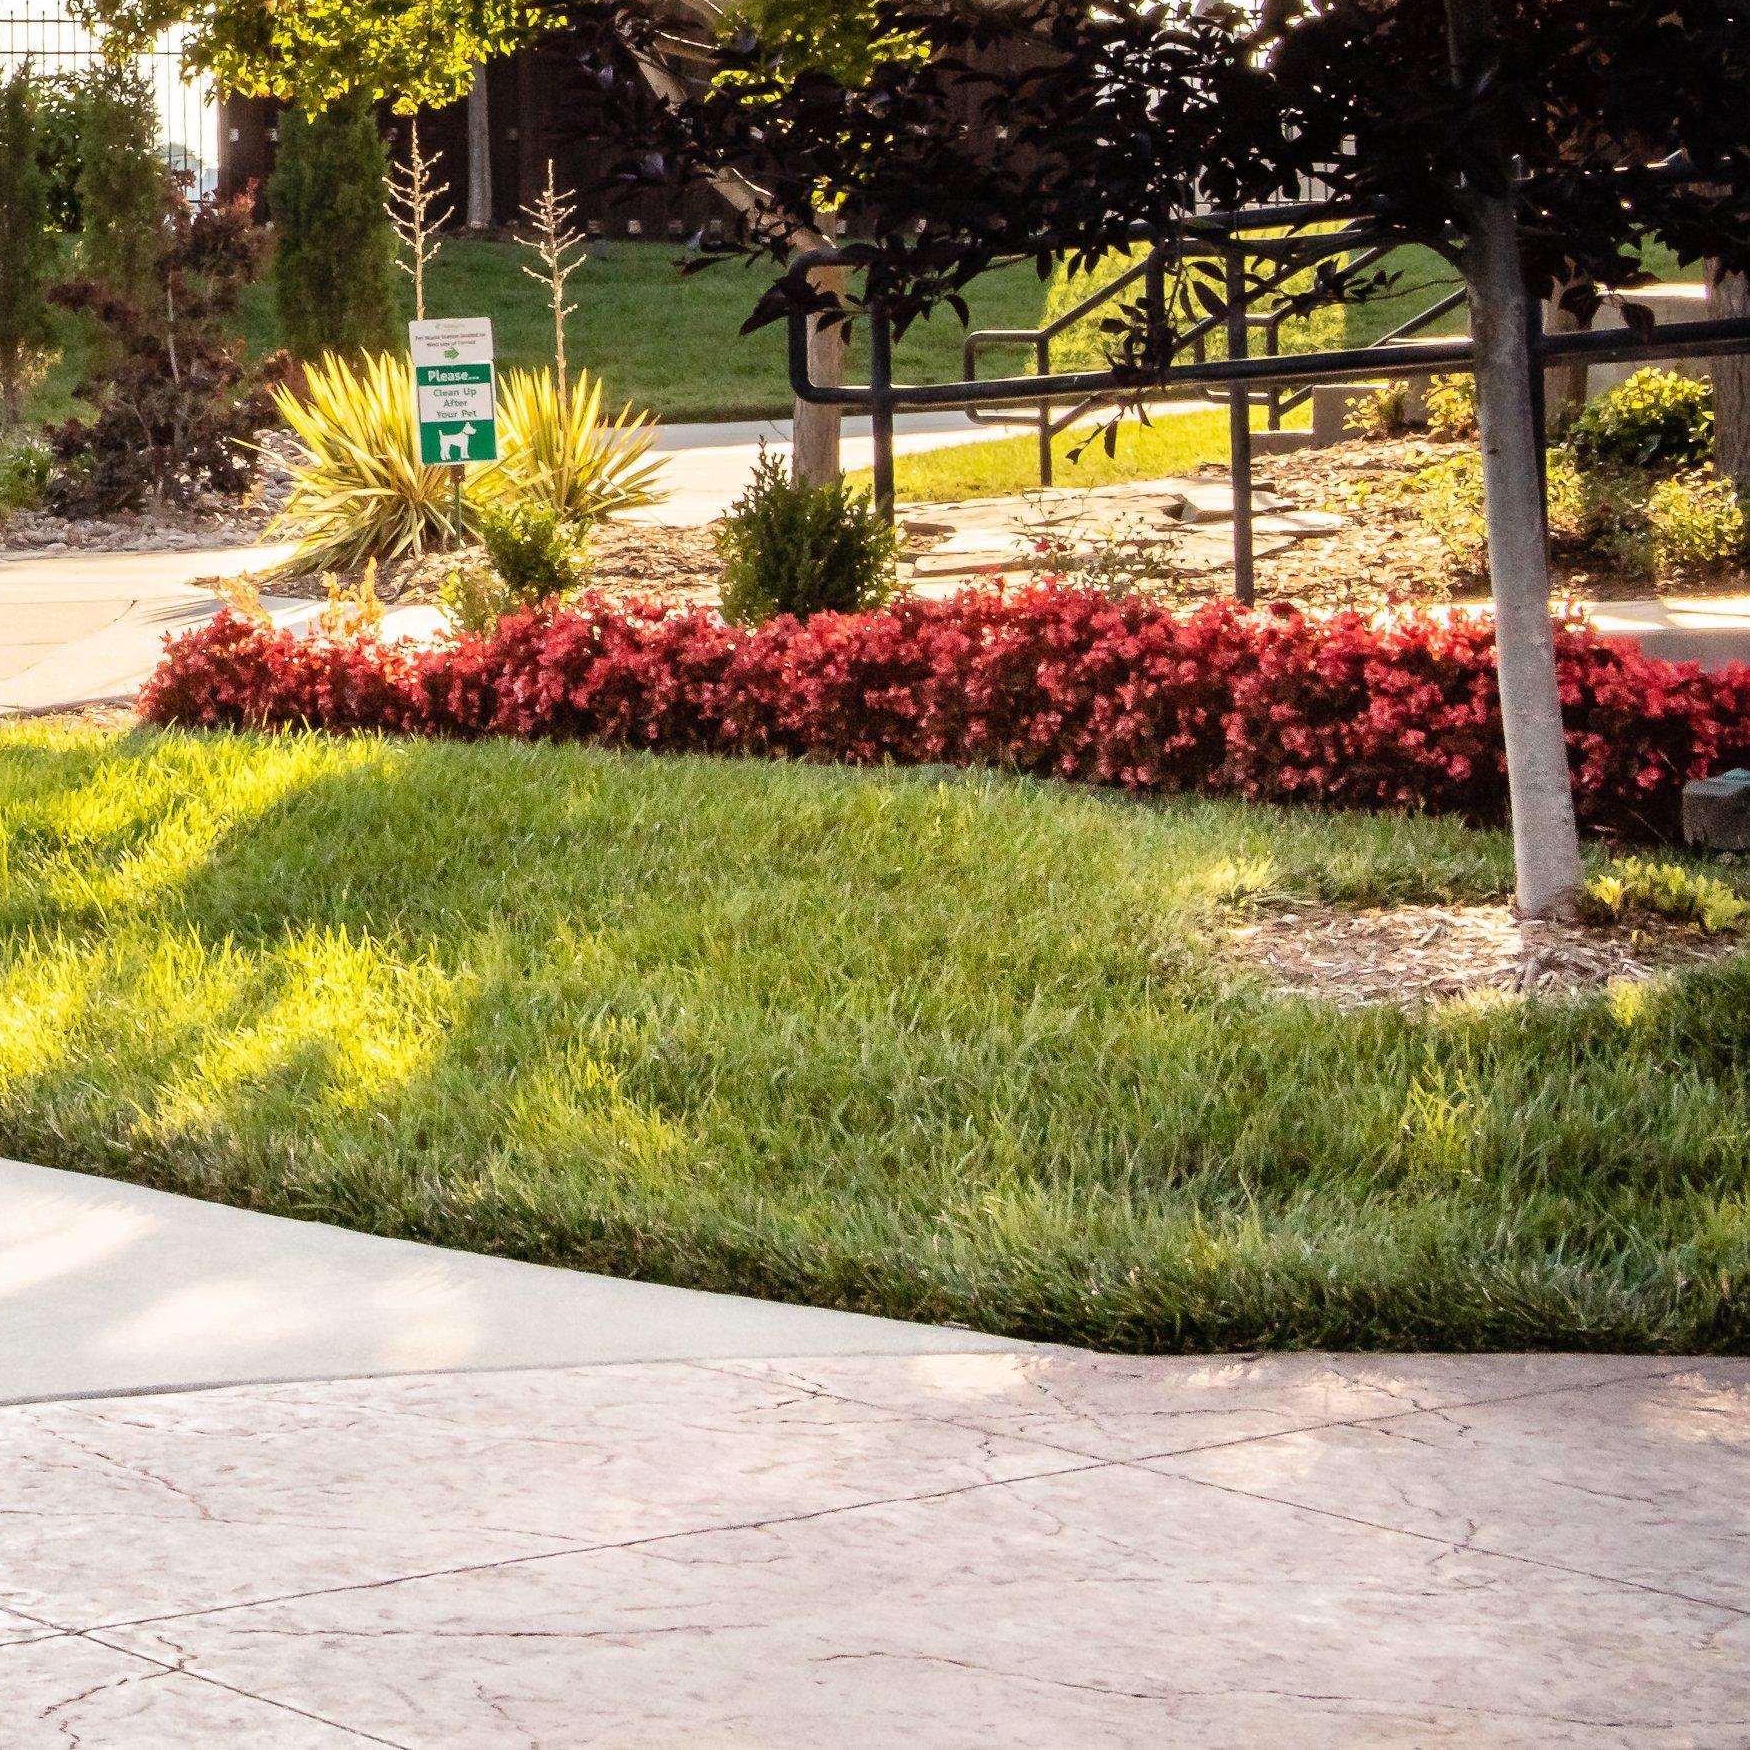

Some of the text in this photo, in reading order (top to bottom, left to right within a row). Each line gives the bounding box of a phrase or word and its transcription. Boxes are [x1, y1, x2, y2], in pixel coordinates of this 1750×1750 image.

[428, 370, 480, 382] Please...
[433, 388, 477, 398] Clean Up
[443, 399, 468, 408] After
[436, 409, 477, 419] Your Pet
